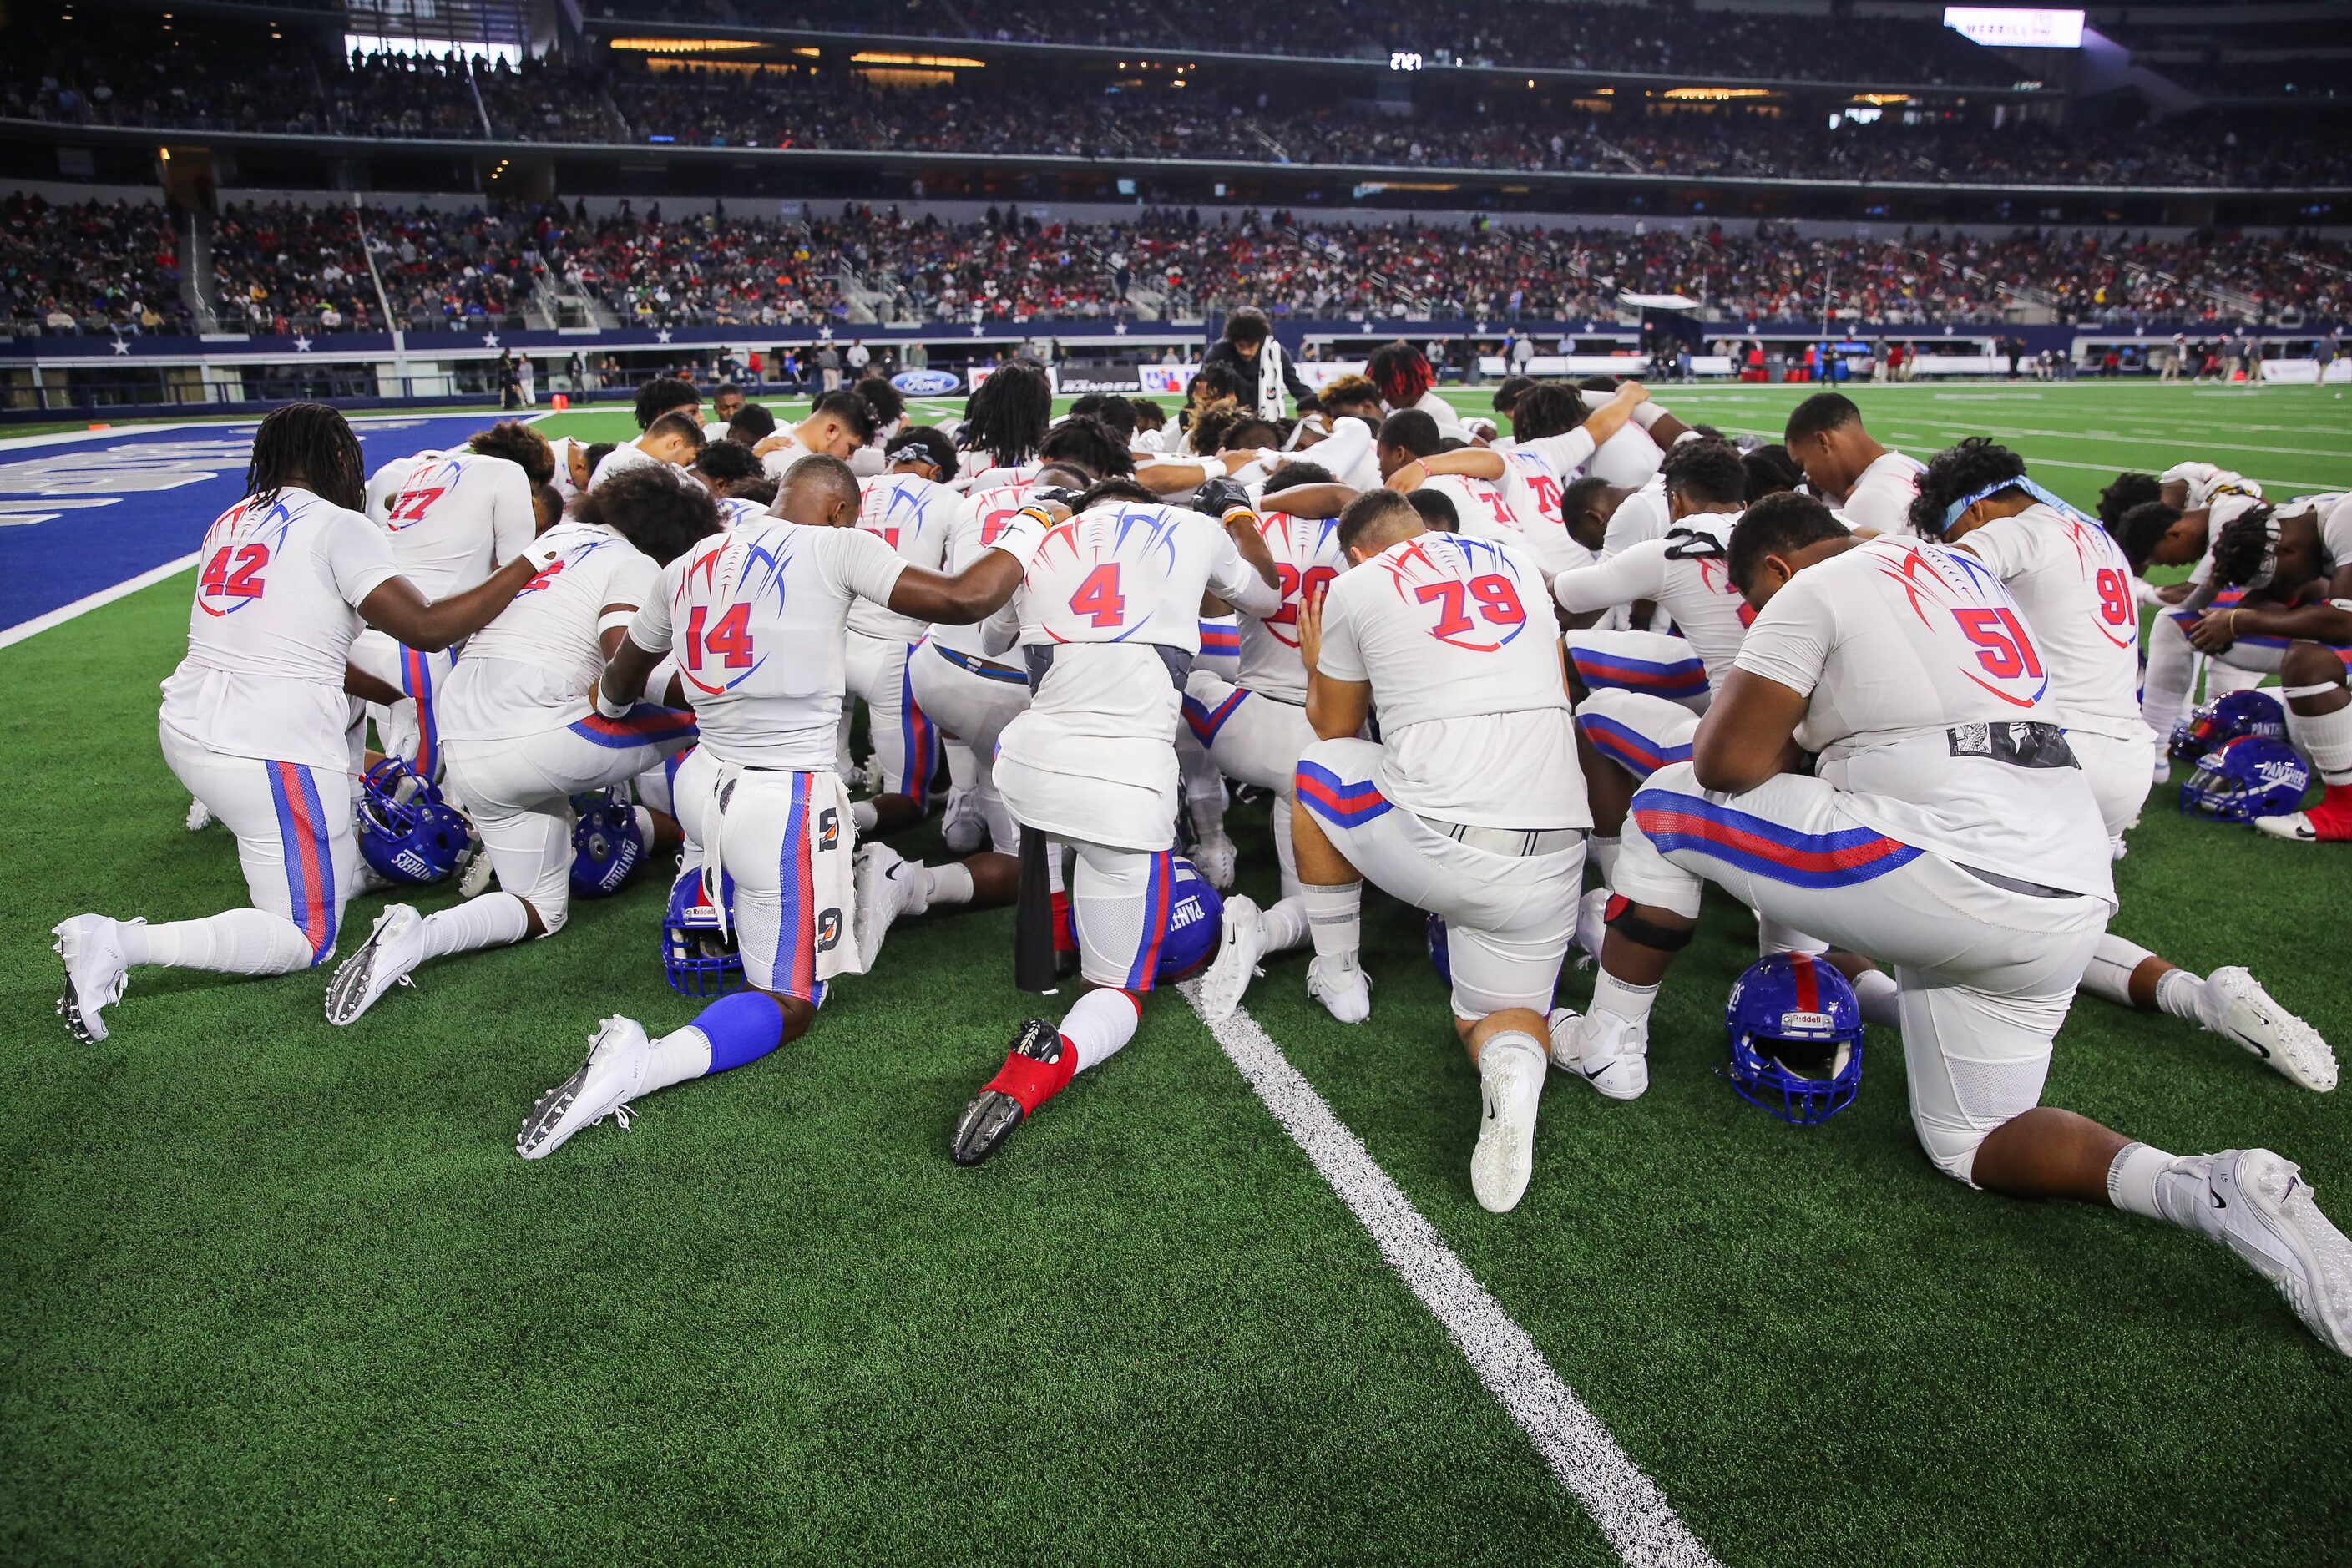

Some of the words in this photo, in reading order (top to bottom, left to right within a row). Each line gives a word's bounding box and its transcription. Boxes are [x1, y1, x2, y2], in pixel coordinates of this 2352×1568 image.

[903, 376, 947, 392] Ford
[1060, 381, 1141, 392] RANGER
[201, 543, 270, 599] 42
[1068, 562, 1125, 628] 4
[2096, 568, 2135, 625] 91
[1414, 574, 1526, 640] 79
[686, 602, 753, 670] 14
[1950, 607, 2044, 679] 51
[602, 840, 638, 892] PANTHERS
